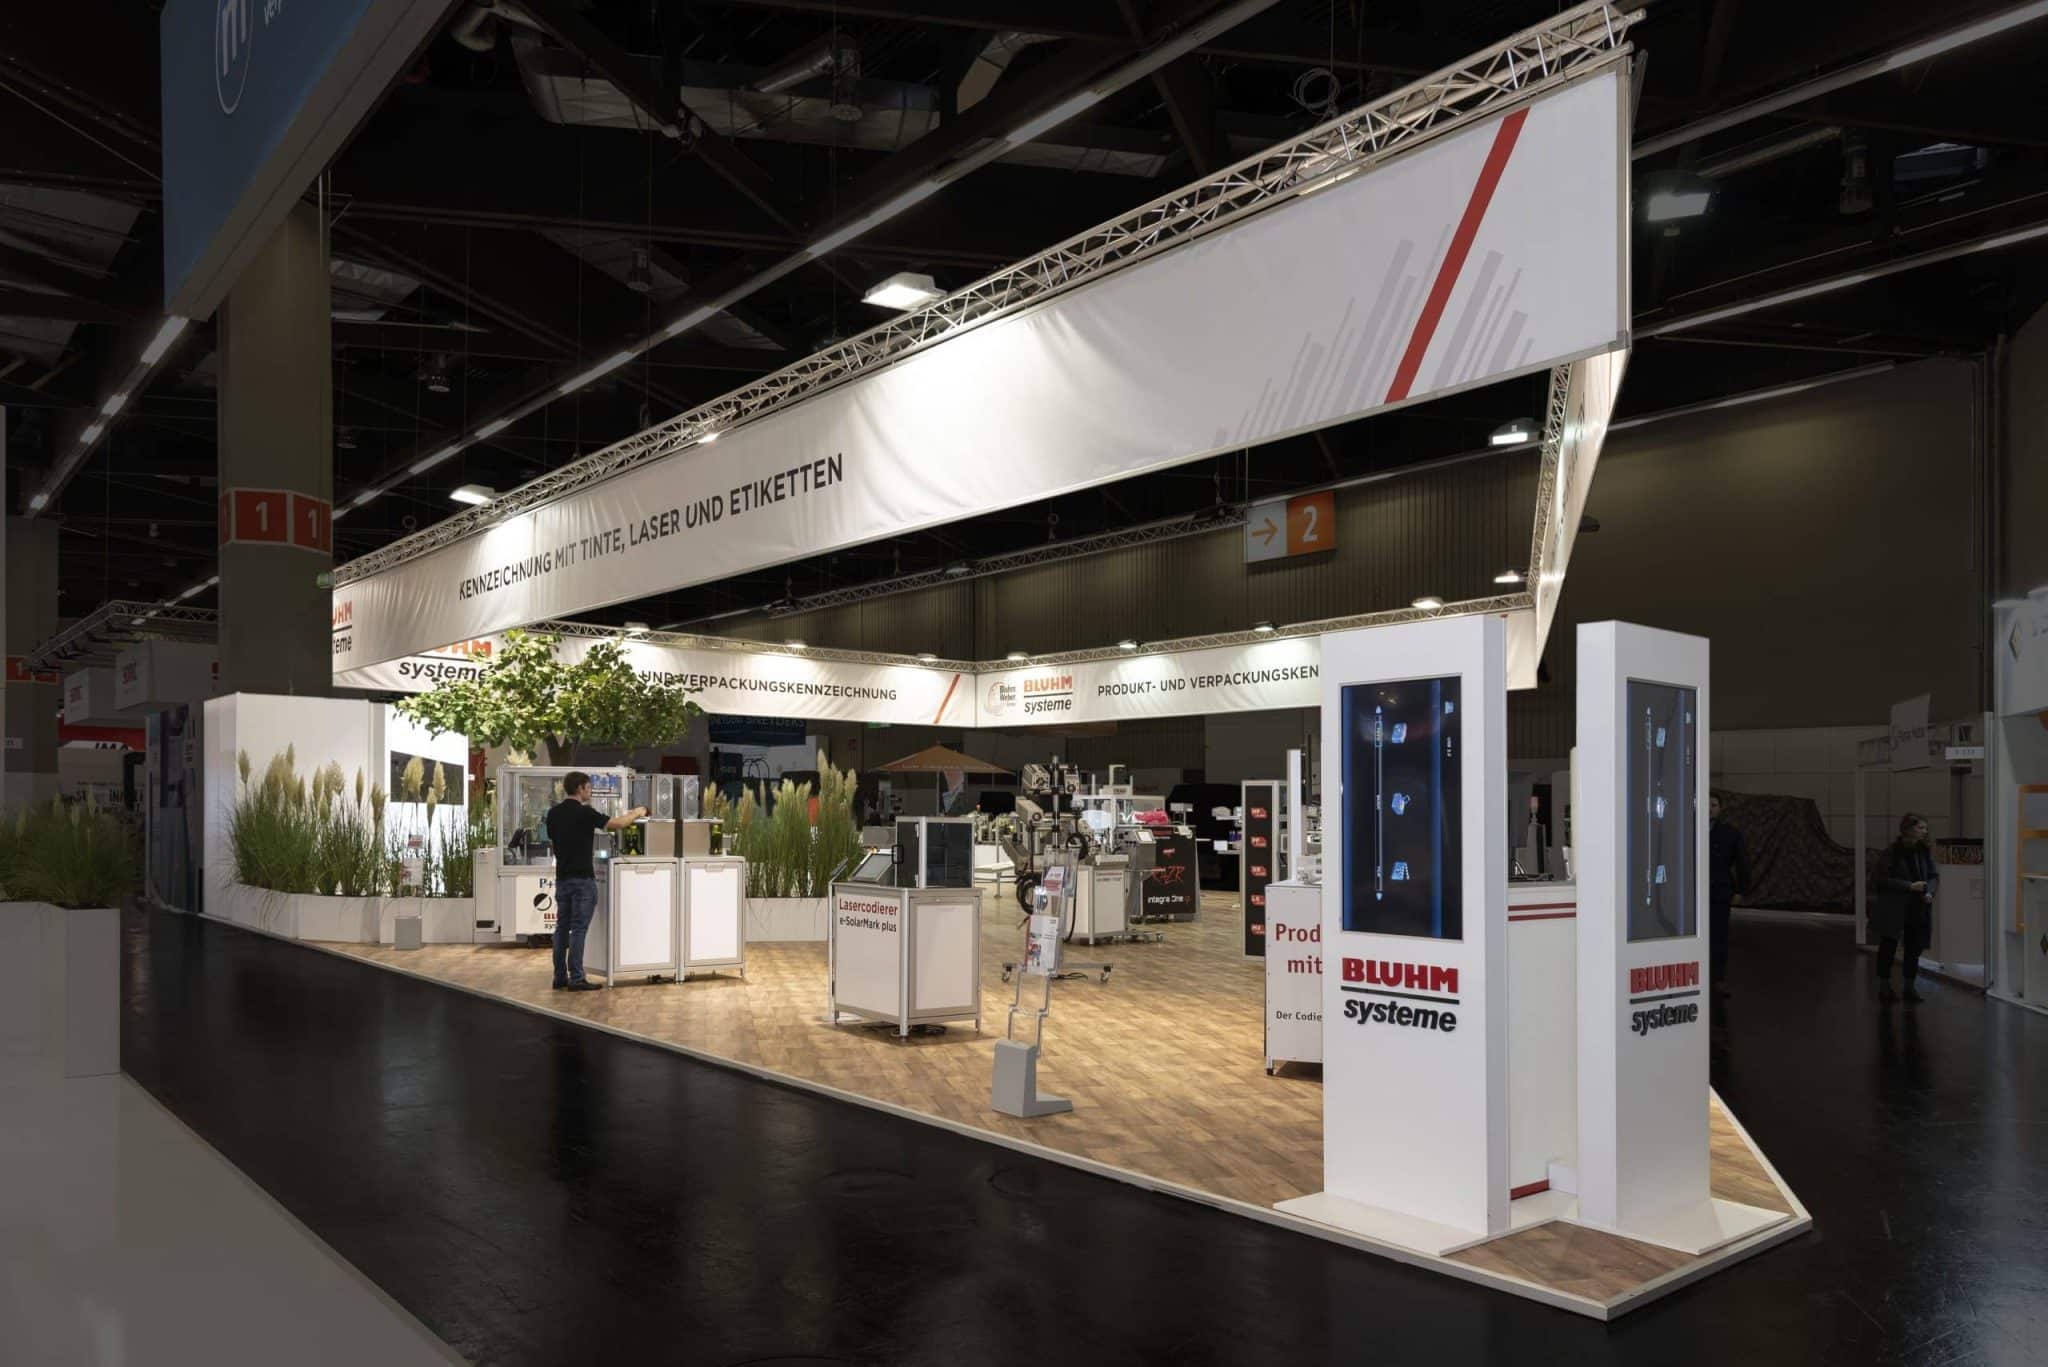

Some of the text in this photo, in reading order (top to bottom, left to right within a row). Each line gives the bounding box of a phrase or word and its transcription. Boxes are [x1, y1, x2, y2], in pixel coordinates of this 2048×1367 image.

[256, 501, 268, 532] 1
[308, 509, 317, 539] 1
[459, 453, 843, 600] KENNZEICHNUNG MIT TINTE, LASER UND ETIKETTEN
[1302, 505, 1319, 542] 2
[399, 662, 492, 681] systeme
[1023, 675, 1072, 692] BLUHM
[1098, 664, 1320, 696] PRODUKT- UND VERPACKUNGSKEN
[681, 673, 897, 701] VERPACKUNGSKENNZEICHNUNG
[1024, 699, 1072, 715] systeme
[839, 898, 898, 916] Lasercodierer
[881, 920, 897, 932] plus
[1276, 923, 1321, 943] Prod
[1287, 955, 1323, 975] mit
[1342, 957, 1459, 994] BLUHM
[1630, 961, 1699, 993] BLUHM
[1276, 1010, 1293, 1020] Der
[1343, 999, 1457, 1032] systeme
[1631, 1003, 1699, 1036] systeme
